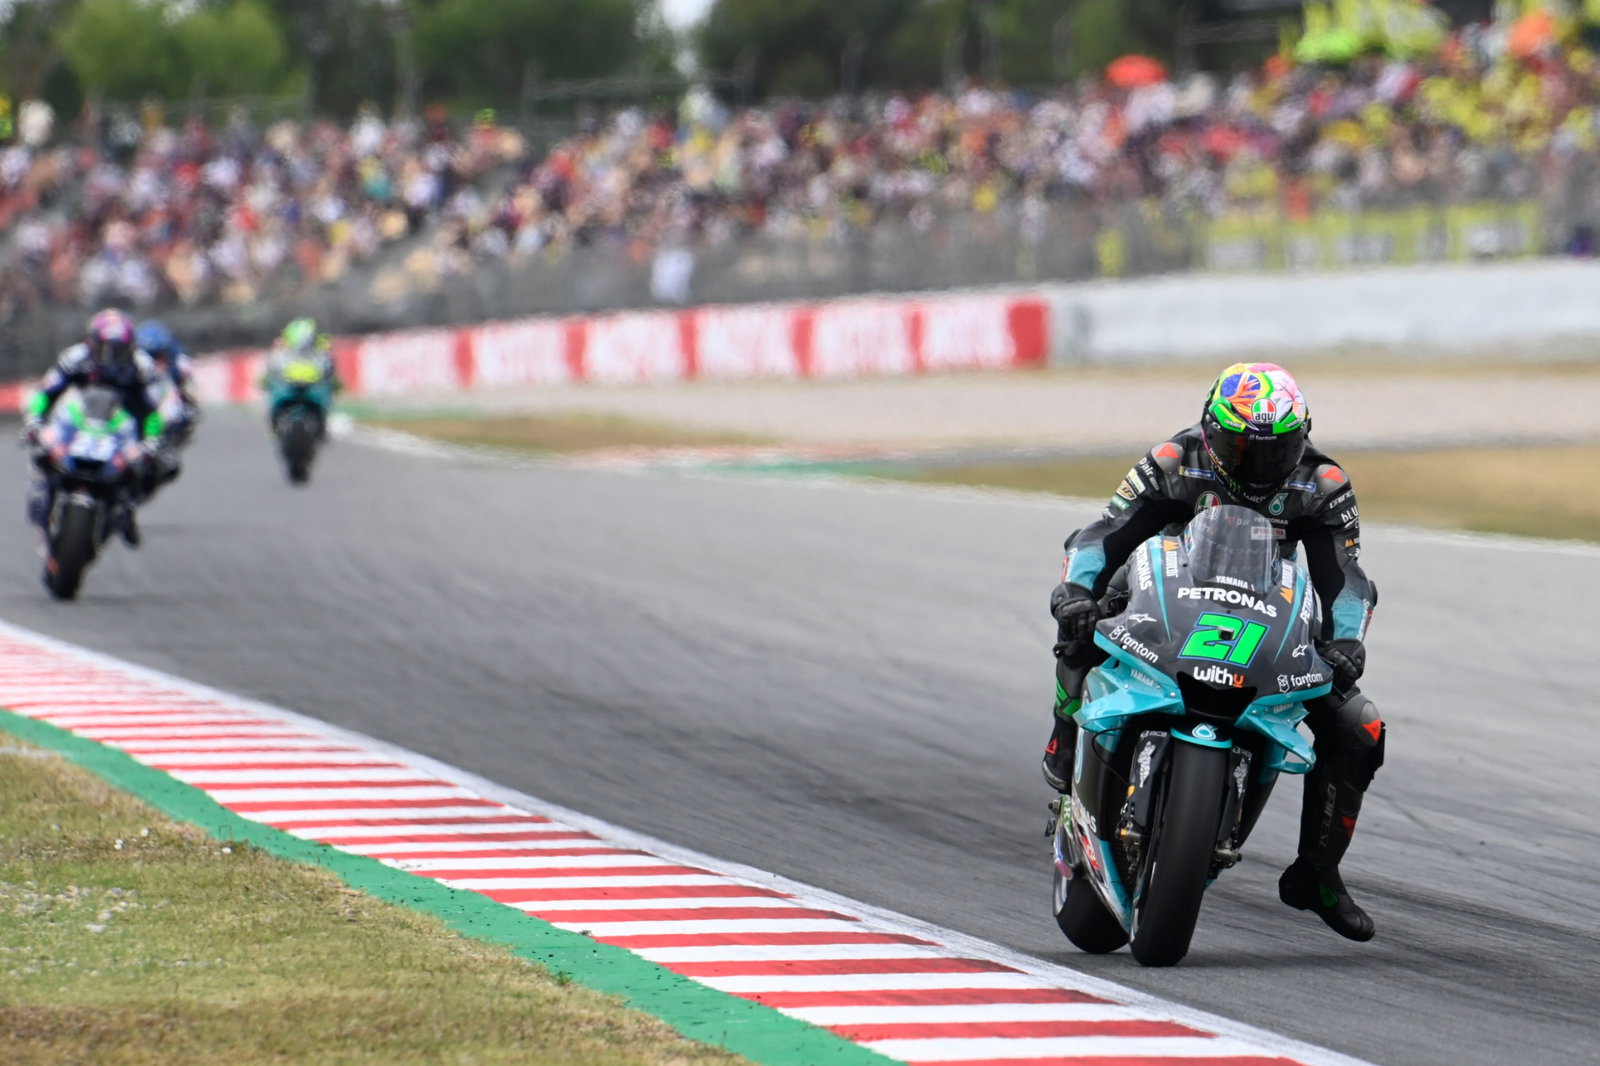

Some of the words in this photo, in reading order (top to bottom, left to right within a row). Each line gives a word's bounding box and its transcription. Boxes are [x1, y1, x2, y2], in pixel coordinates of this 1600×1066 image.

[1255, 412, 1274, 422] agv
[1215, 575, 1248, 589] YAMAHA
[1177, 587, 1278, 618] PETRONAS
[1120, 632, 1159, 663] fantom
[1177, 612, 1270, 668] 21
[1131, 668, 1154, 686] YAMAHA
[1291, 673, 1323, 687] fantom
